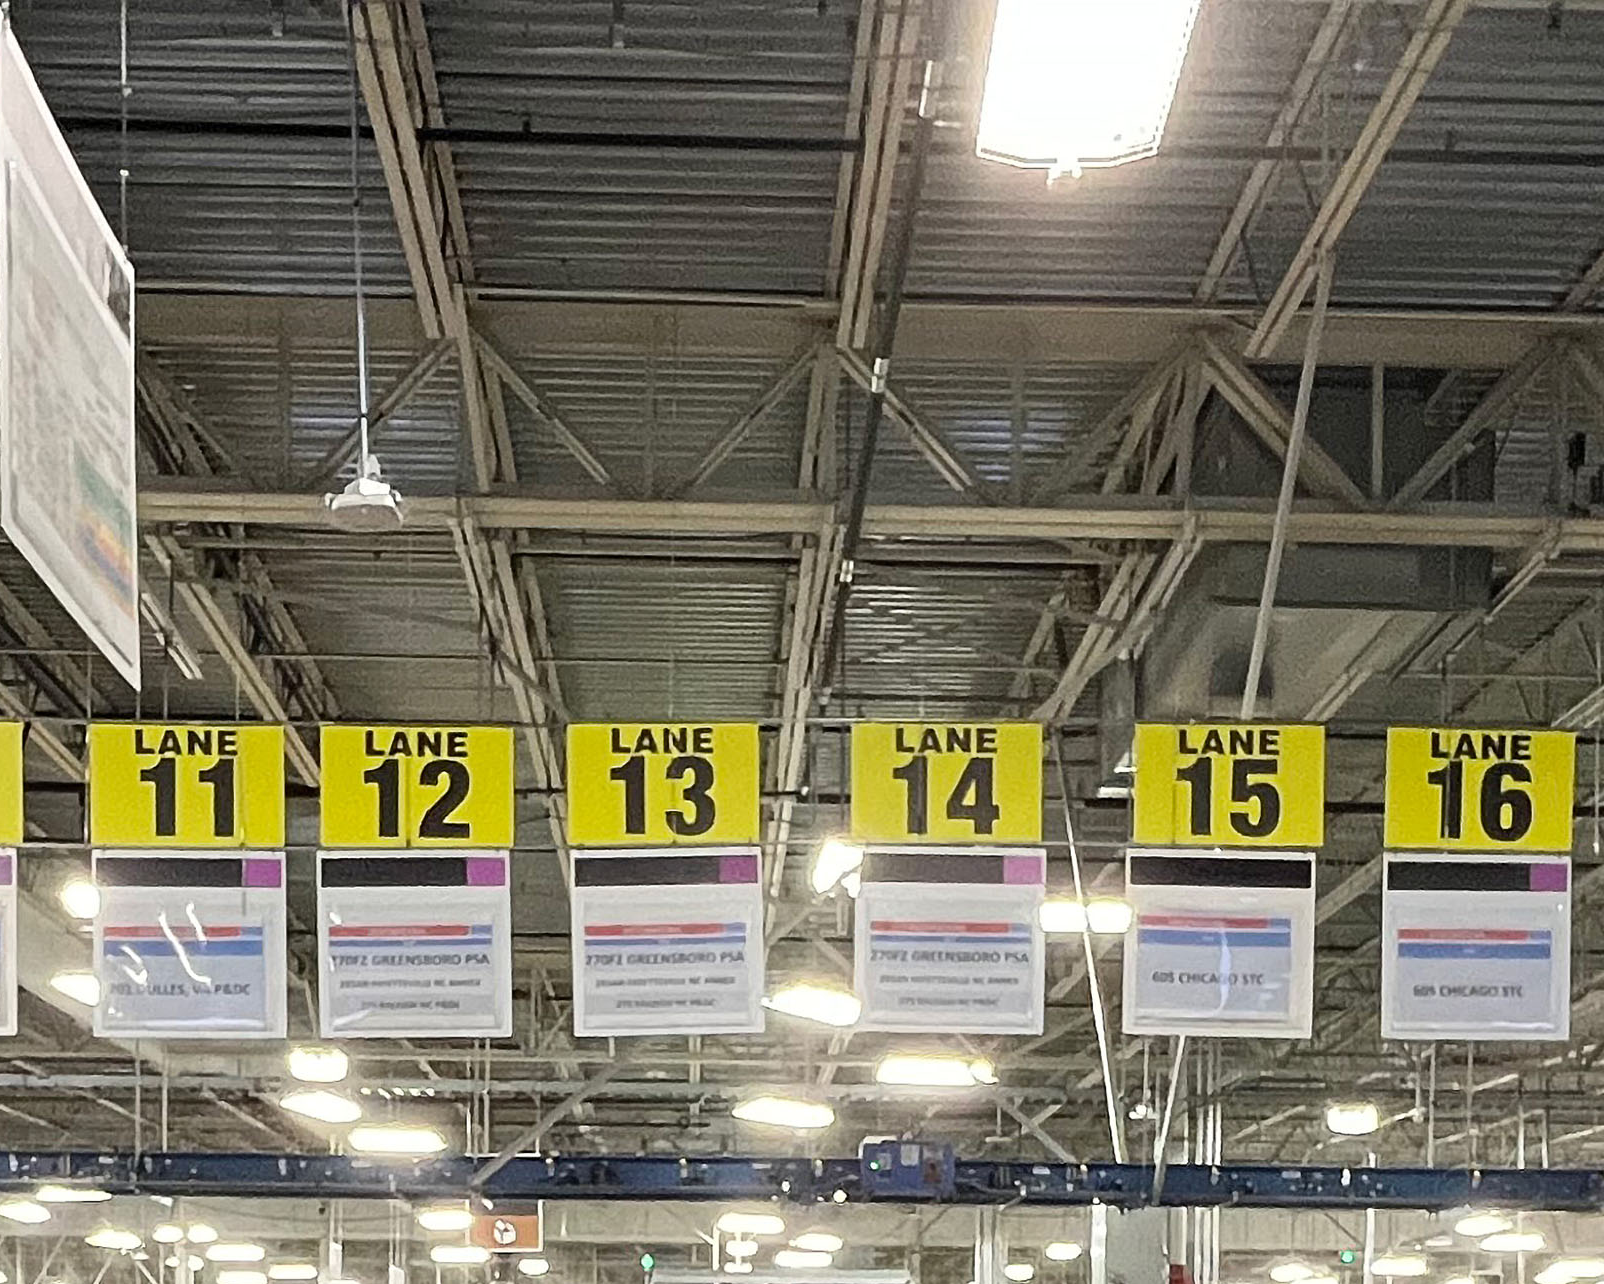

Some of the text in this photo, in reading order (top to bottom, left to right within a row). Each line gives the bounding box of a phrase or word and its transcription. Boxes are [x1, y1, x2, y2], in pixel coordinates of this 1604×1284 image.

[134, 729, 238, 756] LANE
[365, 730, 468, 757] LANE
[611, 727, 714, 754] LANE
[895, 727, 998, 753] LANE
[1178, 729, 1280, 755] LANE
[1431, 732, 1532, 760] LANE
[139, 757, 235, 838] 11
[363, 758, 470, 838] 12
[610, 755, 716, 835] 13
[893, 755, 1000, 835] 14
[1176, 756, 1281, 838] 15
[1427, 759, 1533, 841] 16
[371, 954, 461, 966] GREENSBORO
[465, 954, 490, 965] PSA
[627, 951, 716, 965] GREENSBORO
[720, 951, 745, 963] PSA
[911, 950, 1001, 963] GREENSBORO
[1005, 952, 1029, 963] PSA
[214, 984, 251, 996] P&DC
[1179, 972, 1238, 985] CHICAO
[1439, 985, 1498, 997] CHICAGO
